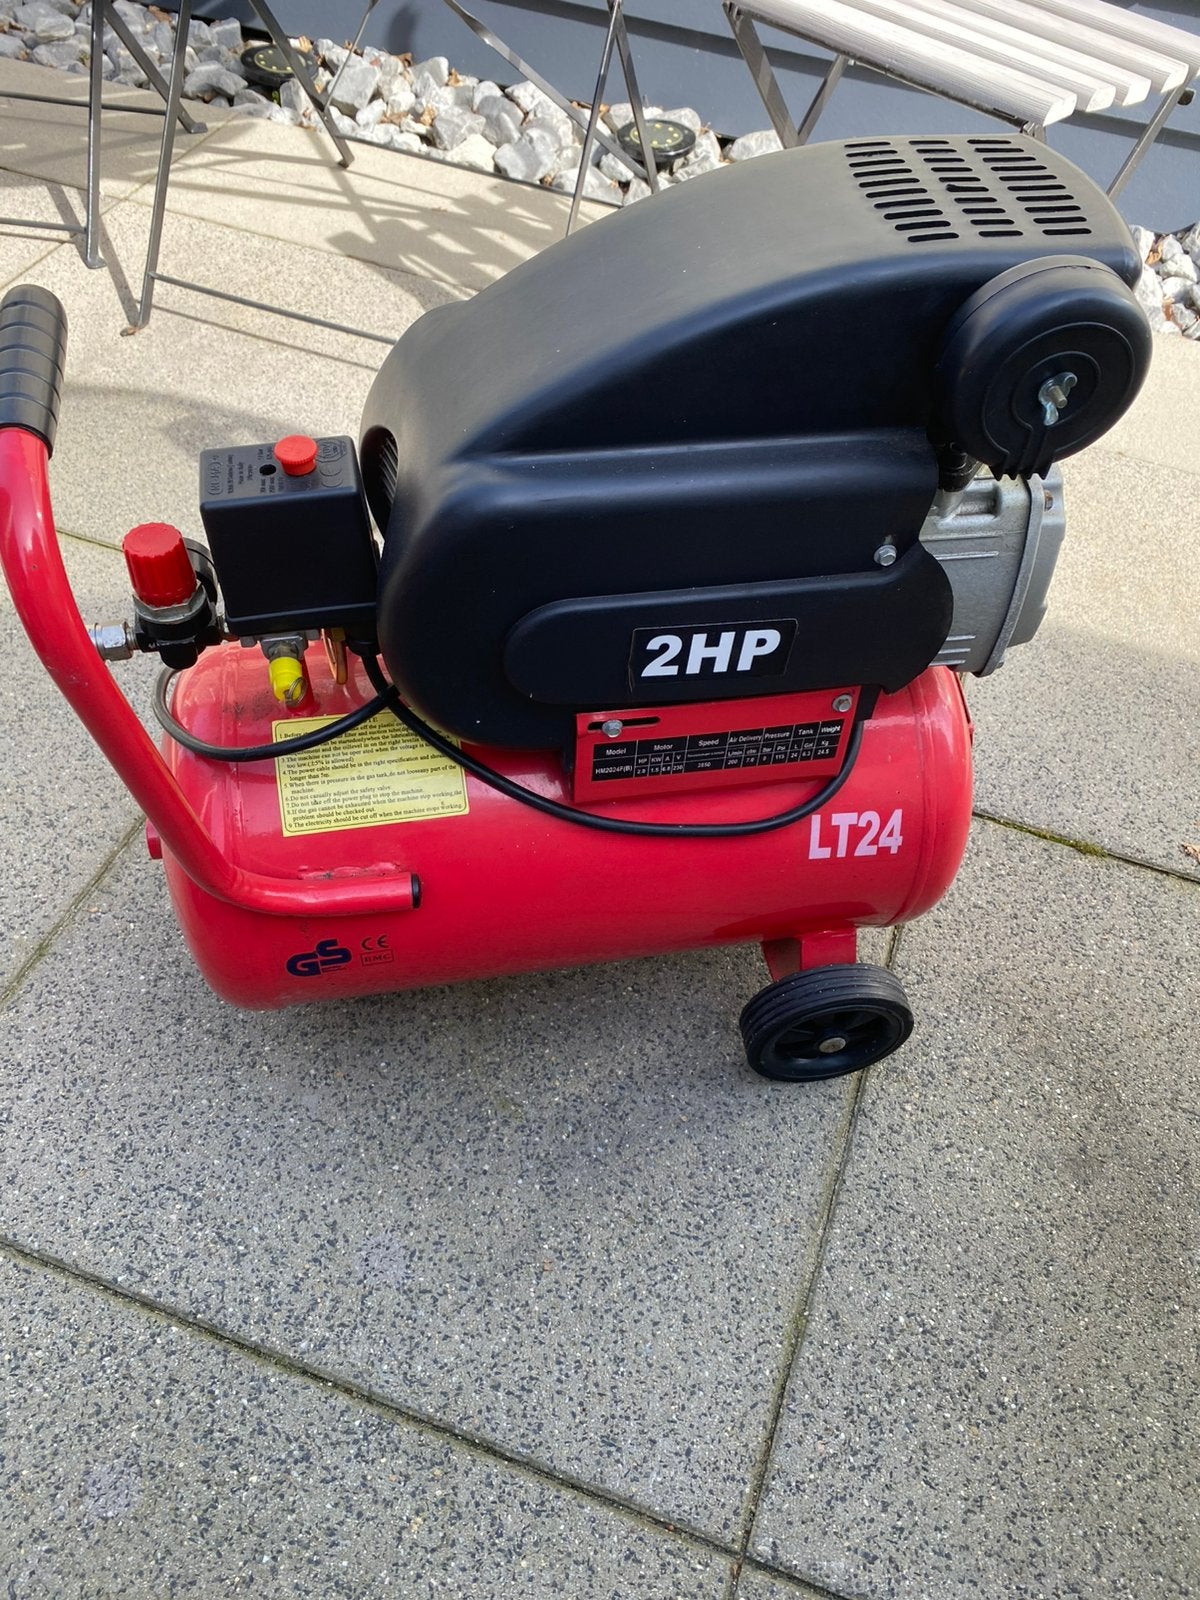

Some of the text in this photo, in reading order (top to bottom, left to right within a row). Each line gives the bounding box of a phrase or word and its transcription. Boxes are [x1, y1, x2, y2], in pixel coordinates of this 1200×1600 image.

[641, 629, 781, 677] 2HP
[310, 791, 332, 800] casually
[360, 786, 375, 794] safety
[360, 793, 371, 801] plug
[292, 814, 315, 822] problem
[305, 819, 332, 827] electricity
[808, 808, 903, 860] LT24
[286, 938, 352, 976] GS
